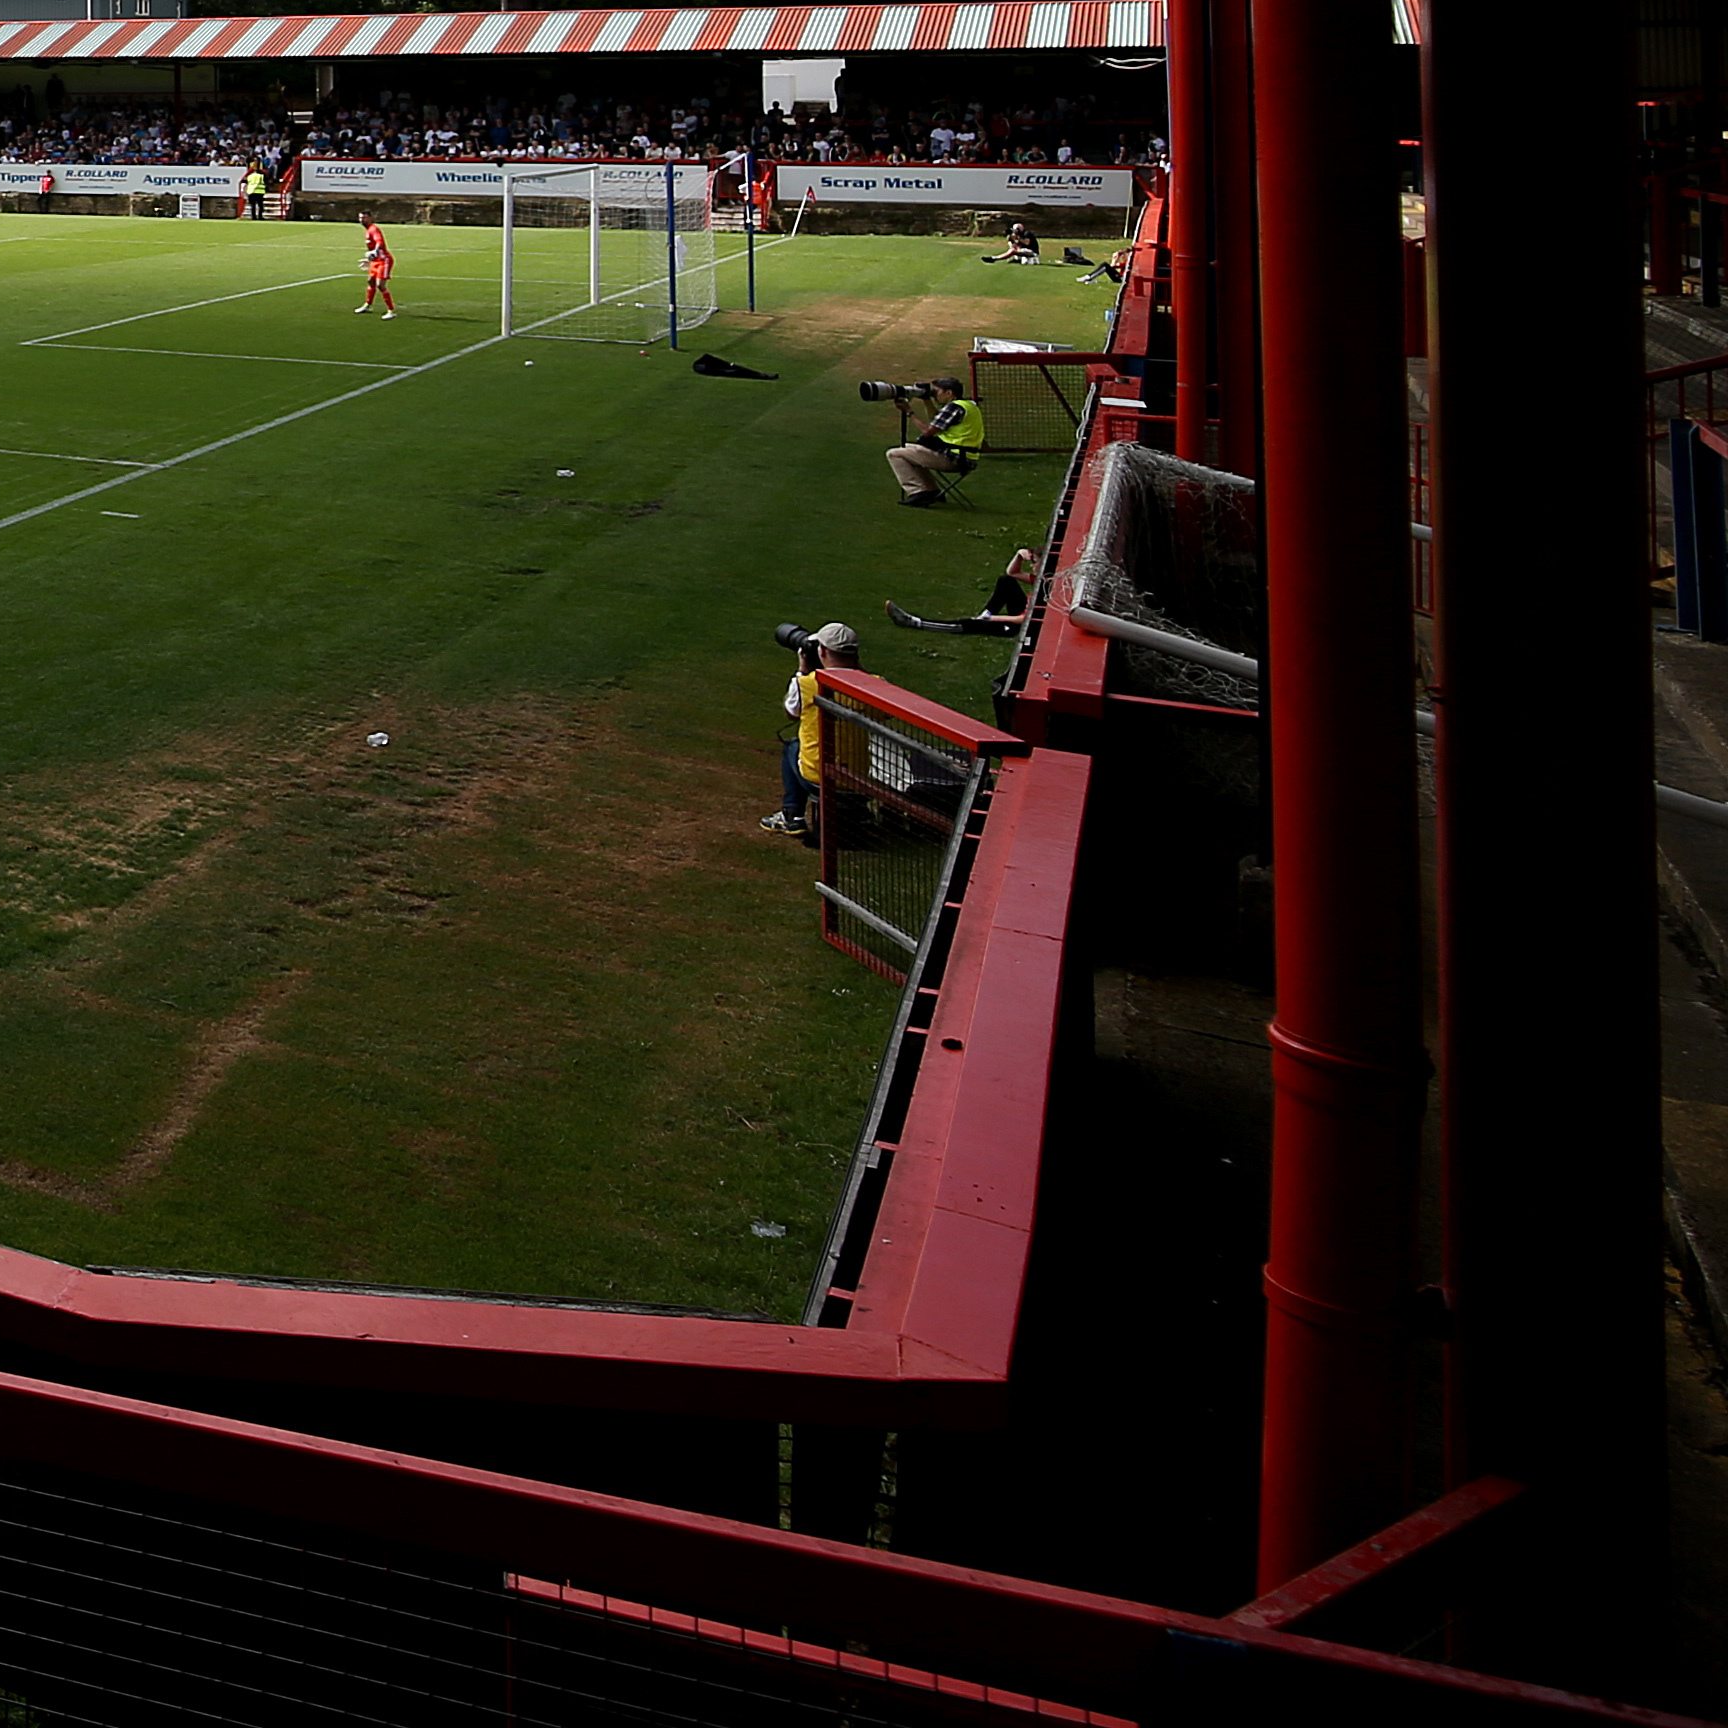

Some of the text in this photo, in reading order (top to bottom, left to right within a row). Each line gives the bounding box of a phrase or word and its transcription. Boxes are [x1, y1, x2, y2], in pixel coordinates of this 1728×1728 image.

[65, 169, 128, 177] R.COLLARD
[315, 166, 385, 175] R.COLLARD
[143, 174, 231, 186] Aggregates
[435, 172, 503, 183] Wheelie
[1007, 175, 1103, 185] R.COLLARD
[821, 176, 943, 190] Scrap Metal
